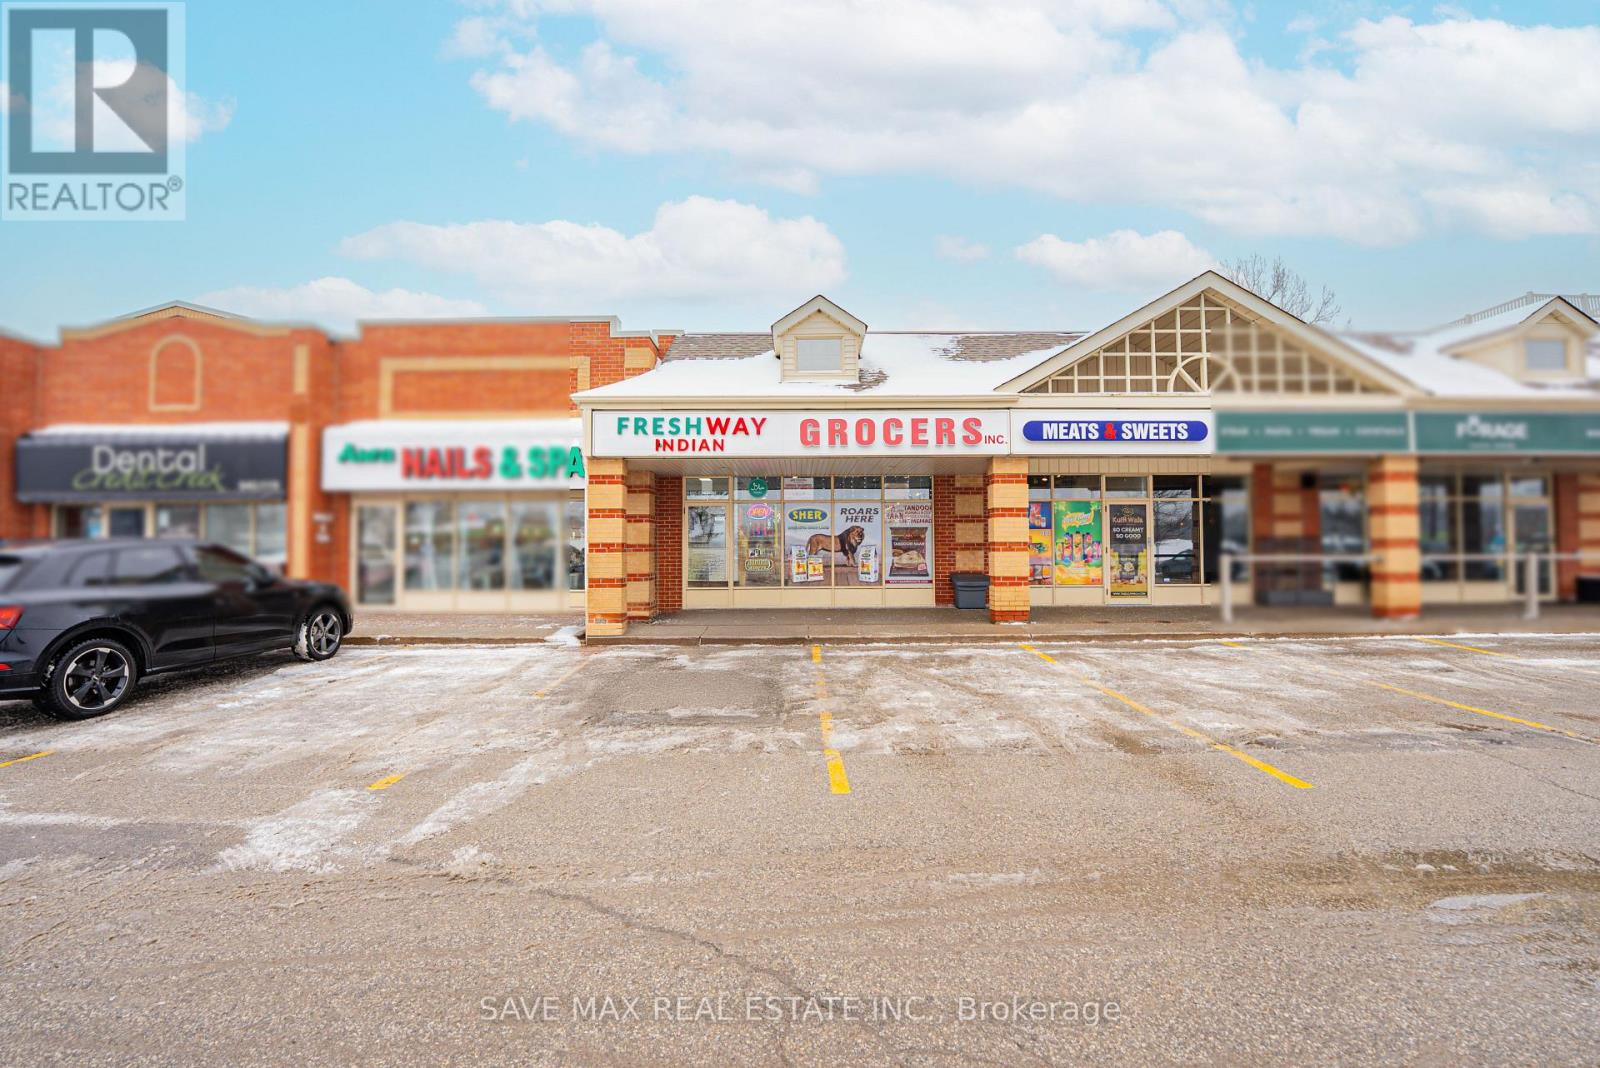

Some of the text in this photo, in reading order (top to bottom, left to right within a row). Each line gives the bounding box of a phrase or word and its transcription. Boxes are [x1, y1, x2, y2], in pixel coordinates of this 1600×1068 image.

[616, 416, 1008, 447] FRESHWAY GROCERS INC.
[1042, 422, 1189, 440] MEATS & SWEETS
[655, 438, 724, 452] INDIAN
[92, 445, 206, 474] Dental
[402, 447, 492, 479] NAILS
[499, 445, 522, 479] &
[528, 445, 585, 479] SPA
[793, 510, 822, 520] SHER
[840, 507, 879, 515] ROARS
[845, 515, 875, 523] HERE
